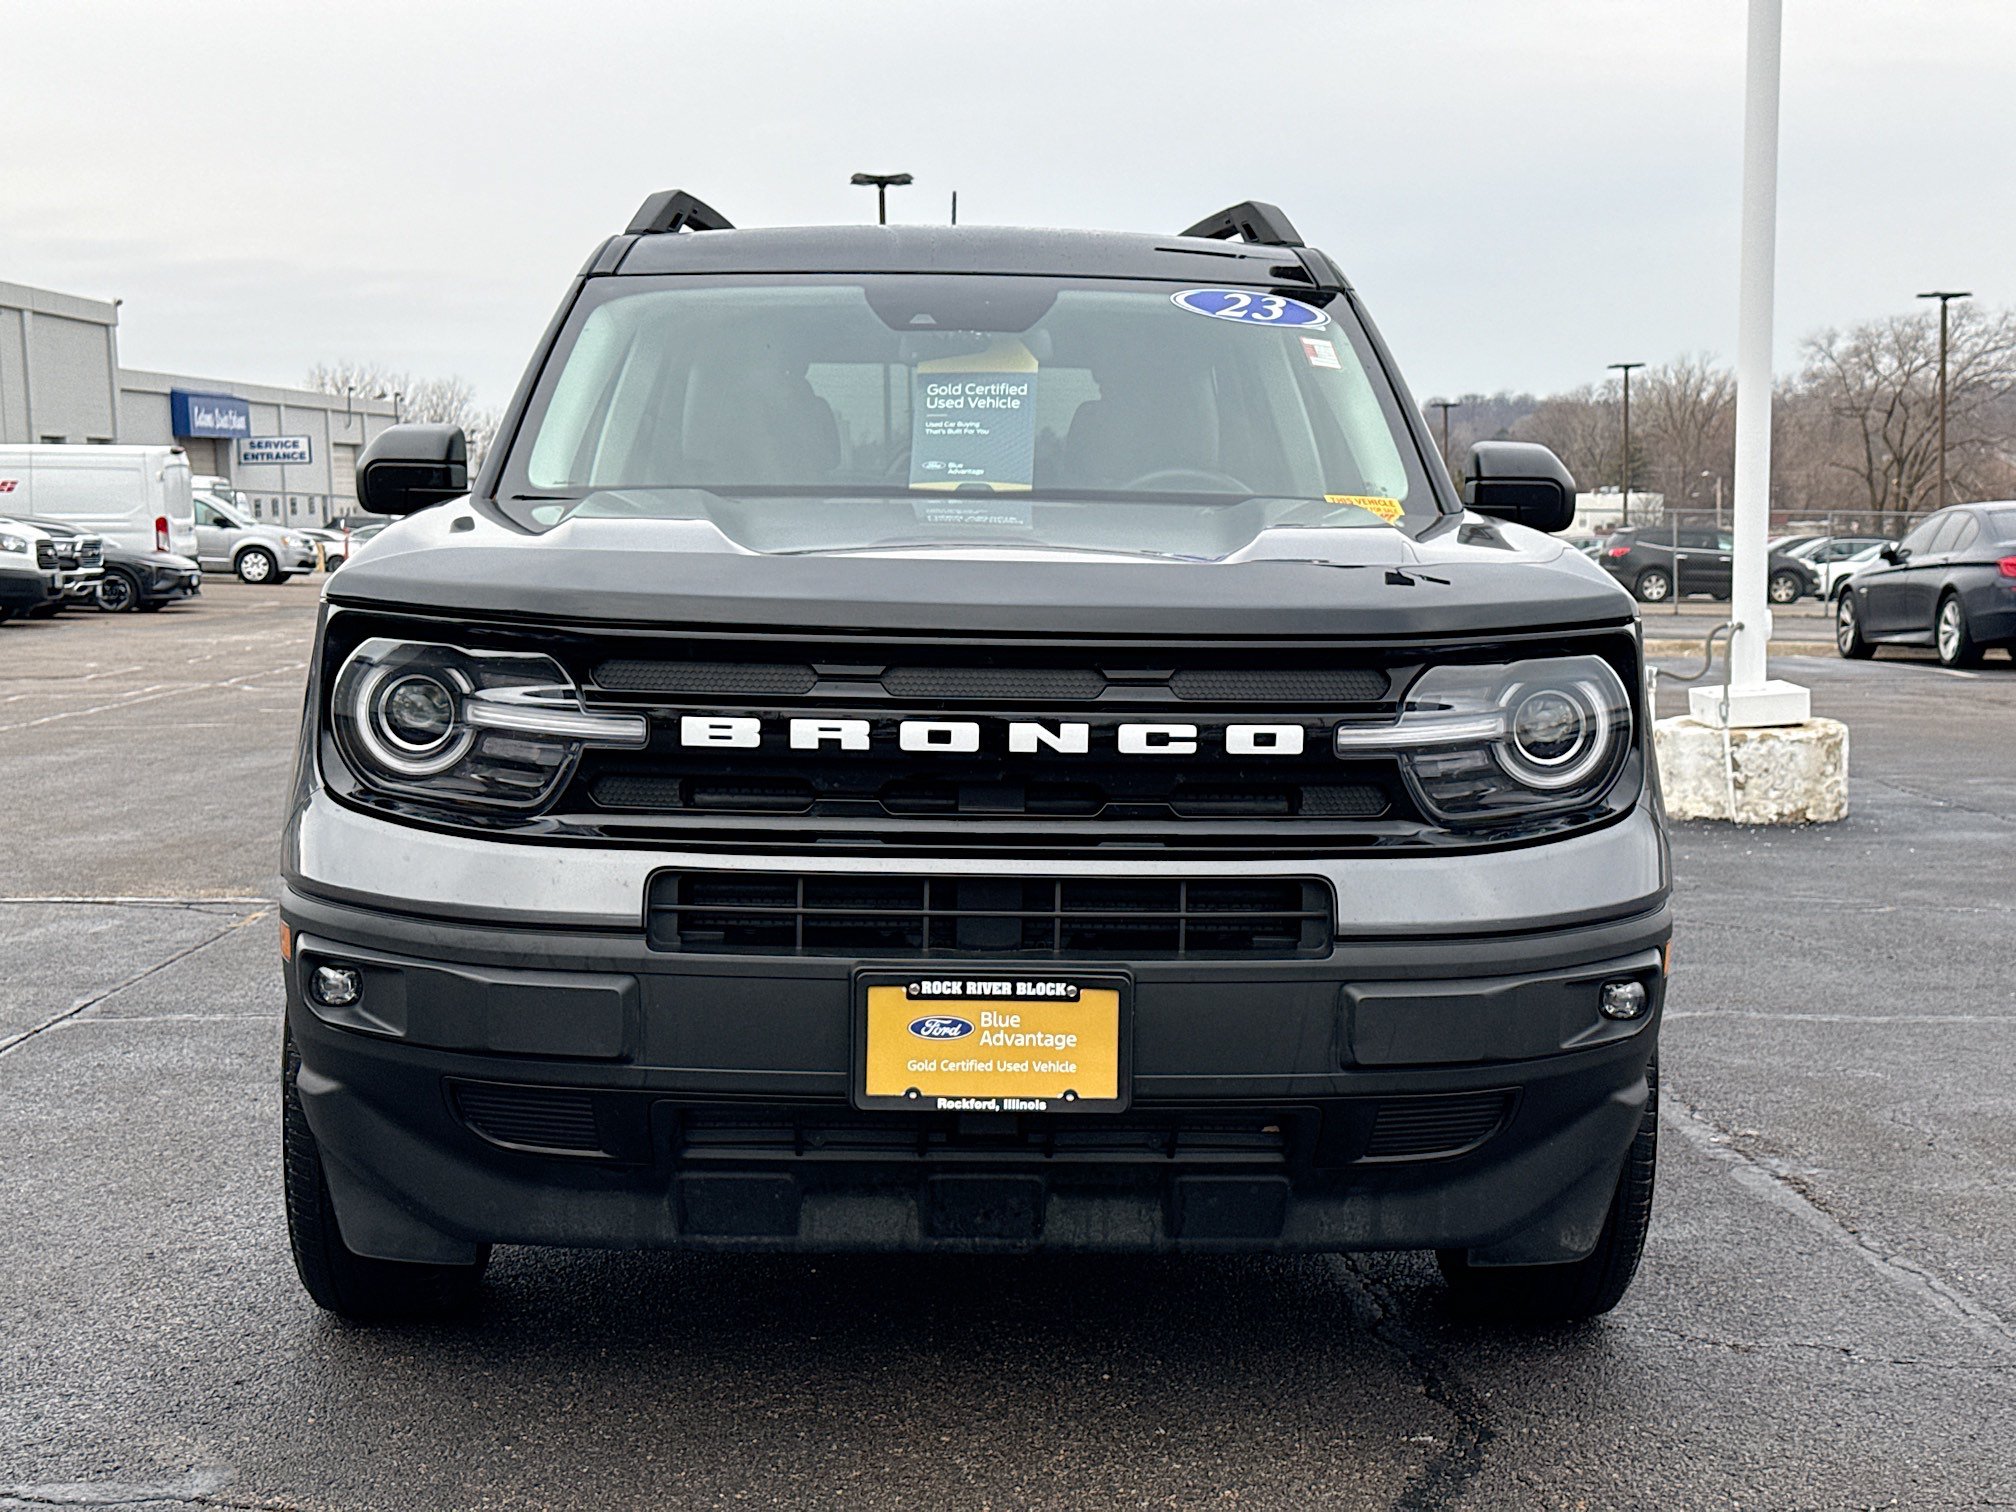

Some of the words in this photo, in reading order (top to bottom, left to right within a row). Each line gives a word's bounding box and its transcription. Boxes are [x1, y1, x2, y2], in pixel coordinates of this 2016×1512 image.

[1216, 293, 1288, 321] 23
[927, 383, 962, 396] Gold
[965, 383, 1028, 396] Certified
[927, 396, 964, 409] Used
[968, 396, 1021, 409] Vehicle
[957, 421, 980, 430] Buying
[249, 440, 300, 450] SERVICE
[243, 451, 307, 462] ENTRANCE
[947, 468, 985, 476] Advantage
[1330, 496, 1353, 505] THIS
[1355, 498, 1396, 508] VEHICLE
[680, 715, 1304, 755] BRONCO
[921, 981, 963, 996] ROCK
[966, 981, 1013, 996] RIVER
[1016, 982, 1067, 997] BLOCK
[980, 1011, 1021, 1028] Blue
[920, 1018, 962, 1038] Ford
[979, 1029, 1078, 1051] Advantage
[907, 1059, 936, 1072] Gold
[940, 1059, 993, 1072] Certified
[997, 1060, 1029, 1072] Used
[1032, 1060, 1077, 1073] Vehicle
[937, 1097, 1000, 1112] Rockford,
[1003, 1098, 1047, 1111] Illinois
